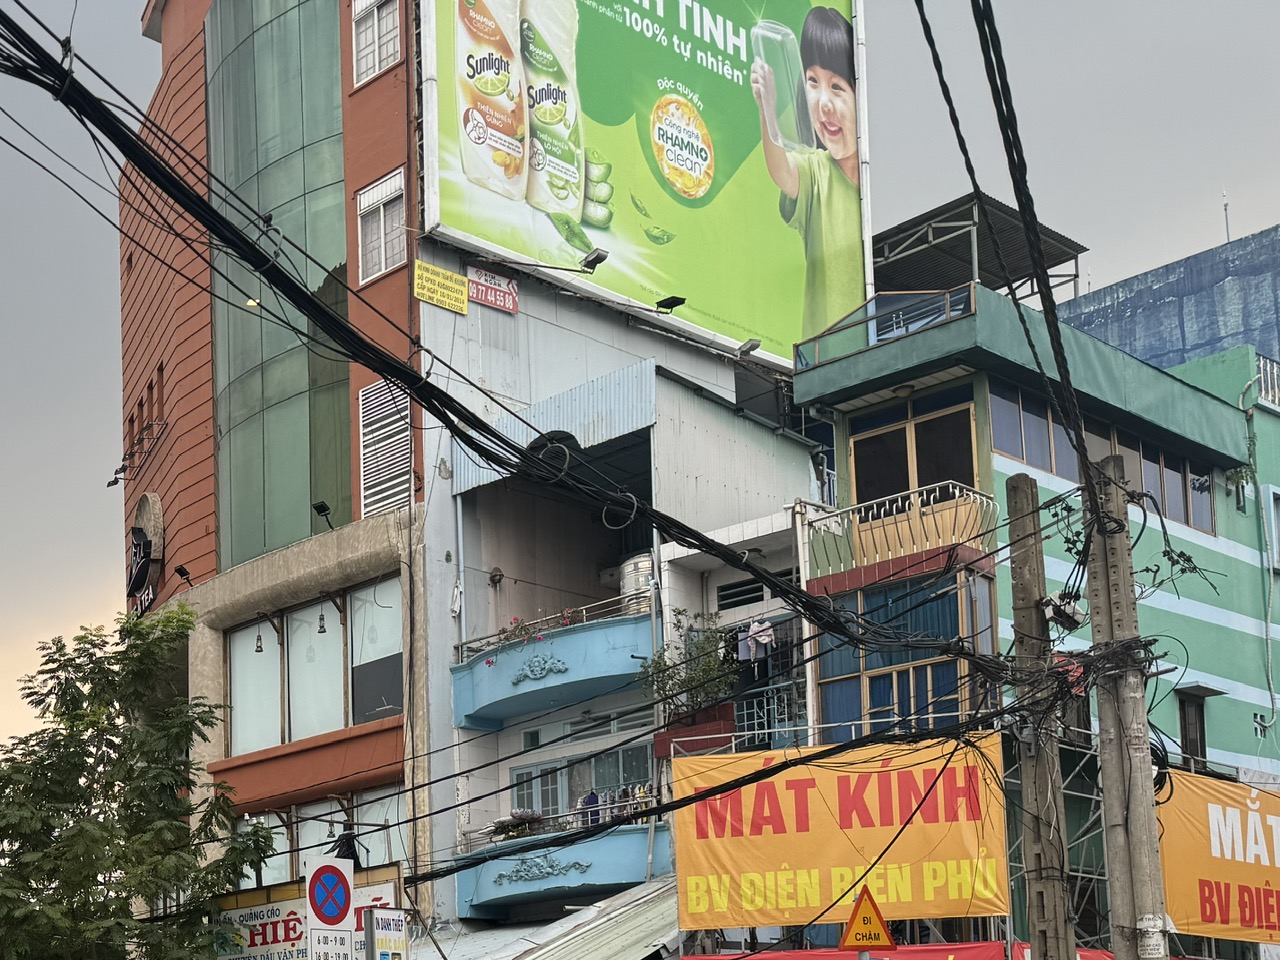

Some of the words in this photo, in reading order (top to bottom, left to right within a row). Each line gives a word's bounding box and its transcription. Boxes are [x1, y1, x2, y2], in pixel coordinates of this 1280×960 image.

[623, 6, 668, 47] 100%
[672, 34, 692, 62] tự
[466, 53, 510, 80] Sunlight
[527, 83, 567, 109] Sunlight
[657, 77, 675, 92] Độc
[676, 81, 704, 110] quyền
[657, 126, 709, 162] RHAMNO
[665, 148, 704, 176] clean
[469, 281, 477, 298] 09
[478, 285, 486, 300] 77
[487, 288, 495, 303] 44
[496, 291, 504, 306] 55
[836, 760, 982, 830] KÍNH
[686, 874, 731, 914] BV
[740, 862, 822, 918] ĐIỆN
[924, 846, 998, 901] PHỦ
[238, 908, 265, 924] QUẢNG
[266, 906, 281, 919] CÁO
[1198, 878, 1231, 925] BV
[247, 910, 304, 948] HIỆ
[375, 916, 380, 930] IN
[381, 917, 392, 931] DANH
[862, 916, 872, 925] ĐI
[854, 930, 881, 943] CHẬM
[277, 948, 294, 960] VĂN
[296, 947, 308, 959] PH
